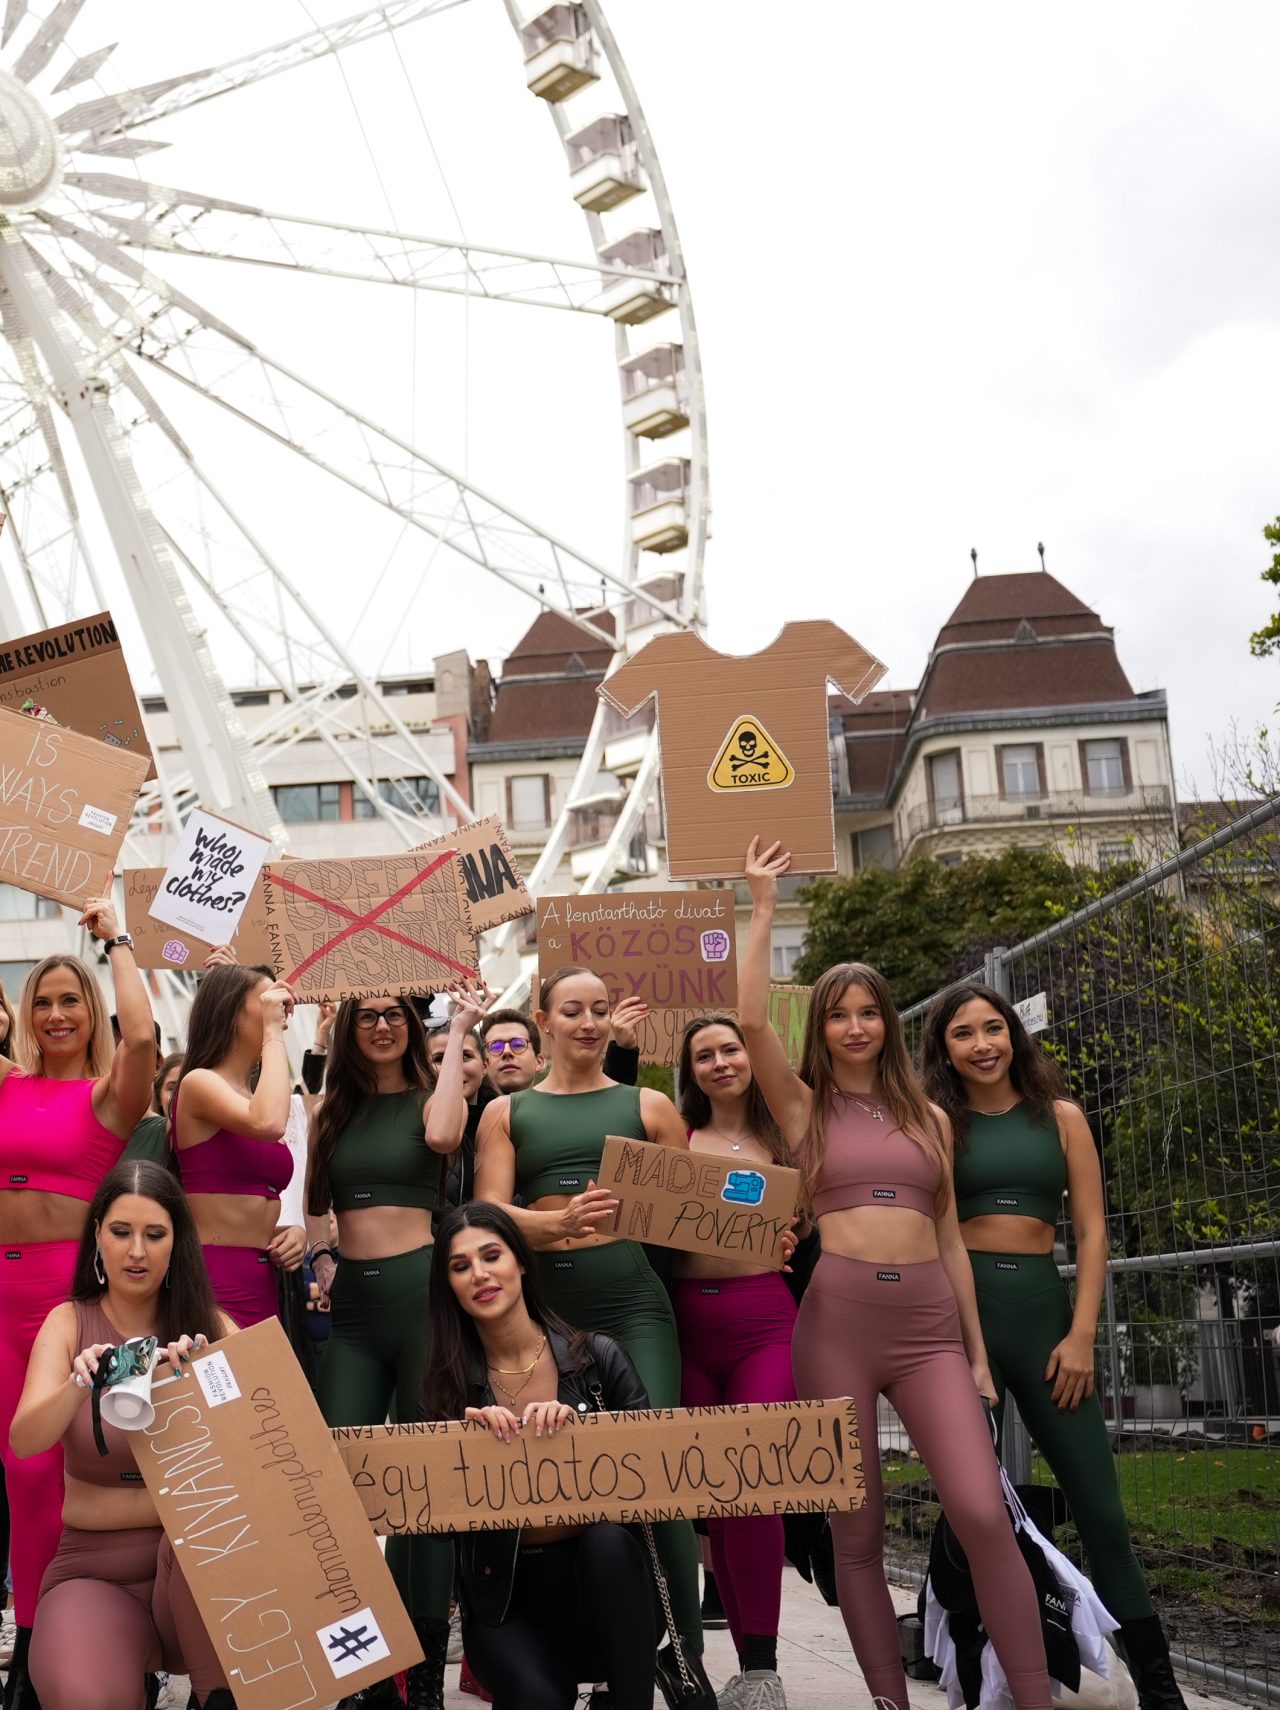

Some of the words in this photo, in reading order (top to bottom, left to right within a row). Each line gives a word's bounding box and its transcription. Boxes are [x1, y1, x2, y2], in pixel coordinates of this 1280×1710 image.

[15, 619, 119, 669] REVOLUTION
[730, 771, 771, 785] TOXIC
[189, 847, 245, 879] made
[191, 866, 224, 889] my
[166, 876, 246, 914] clothes?
[261, 865, 277, 917] FANNA
[281, 855, 461, 932] GREEN
[541, 901, 560, 928] A
[565, 898, 668, 927] fenntartható
[674, 899, 726, 920] divat
[268, 923, 286, 976] FANNA
[283, 920, 477, 991] WASHING
[548, 936, 562, 950] a
[570, 922, 697, 962] KÖZÖS
[339, 988, 391, 1002] FANNA
[399, 982, 449, 998] FANNA
[613, 1140, 722, 1199] MADE
[354, 1192, 372, 1200] FANNA
[874, 1191, 895, 1199] FANNA
[612, 1198, 654, 1239] IN
[667, 1199, 790, 1258] POVERTY
[363, 1269, 380, 1277] FANNA
[878, 1272, 900, 1281] FANNA
[996, 1262, 1018, 1270] FANNA
[610, 1409, 675, 1424] FANNA
[686, 1403, 750, 1419] FANNA
[762, 1398, 826, 1413] FANNA
[385, 1420, 449, 1437] FANNA
[352, 1453, 432, 1528] égy
[452, 1434, 647, 1511] tudatos
[661, 1416, 846, 1504] vásárló!
[469, 1515, 534, 1532] FANNA
[544, 1511, 610, 1528] FANNA
[620, 1505, 686, 1524] FANNA
[696, 1501, 763, 1520] FANNA
[772, 1496, 840, 1513] FANNA
